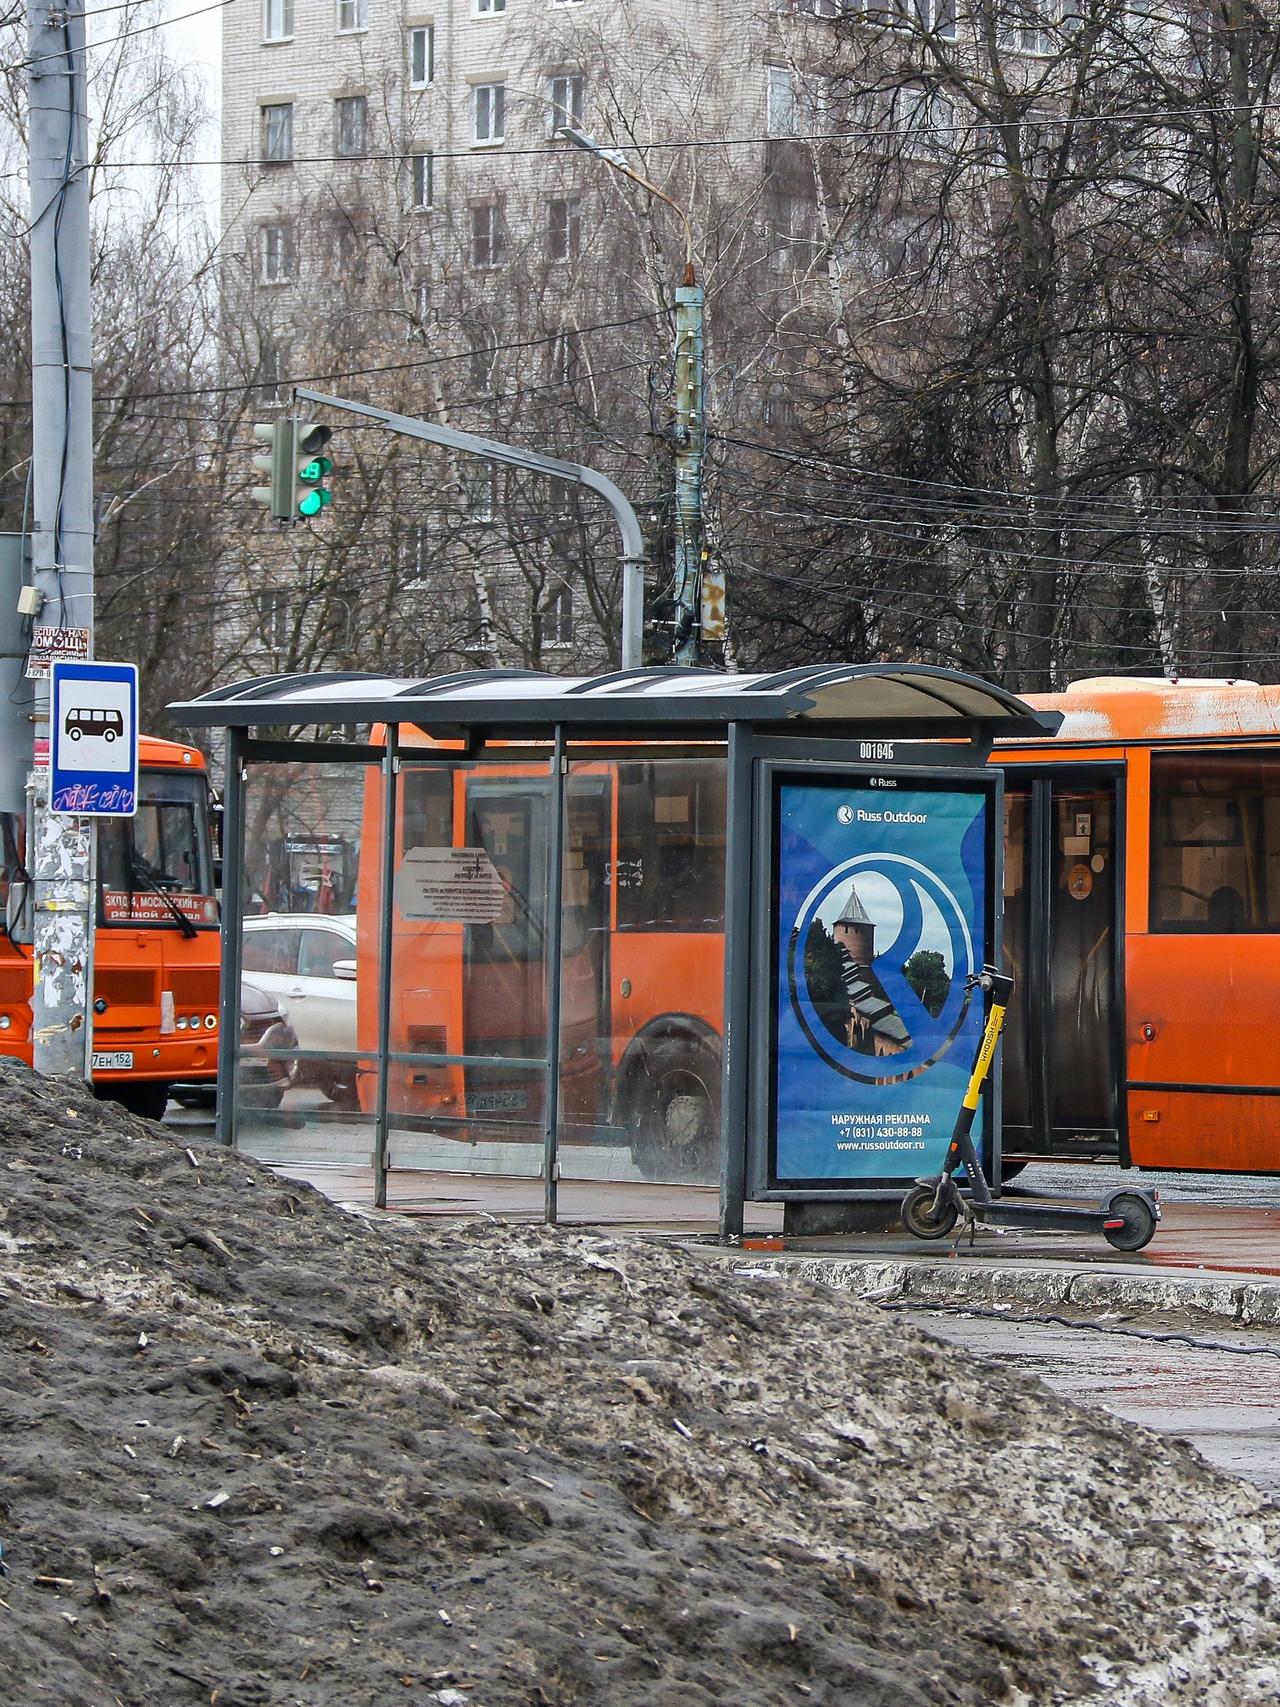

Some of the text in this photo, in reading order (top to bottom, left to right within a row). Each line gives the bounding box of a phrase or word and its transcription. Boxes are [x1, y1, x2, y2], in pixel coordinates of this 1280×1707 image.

[878, 778, 897, 787] Russ
[857, 809, 928, 824] Russ Outdoor
[114, 1053, 131, 1064] 152
[831, 1114, 931, 1125] НАРУЖНАЯ РЕКЛАМА
[839, 1126, 923, 1139] +7 (831) 430-88-88
[836, 1140, 925, 1151] www.russoutdoor.ru
